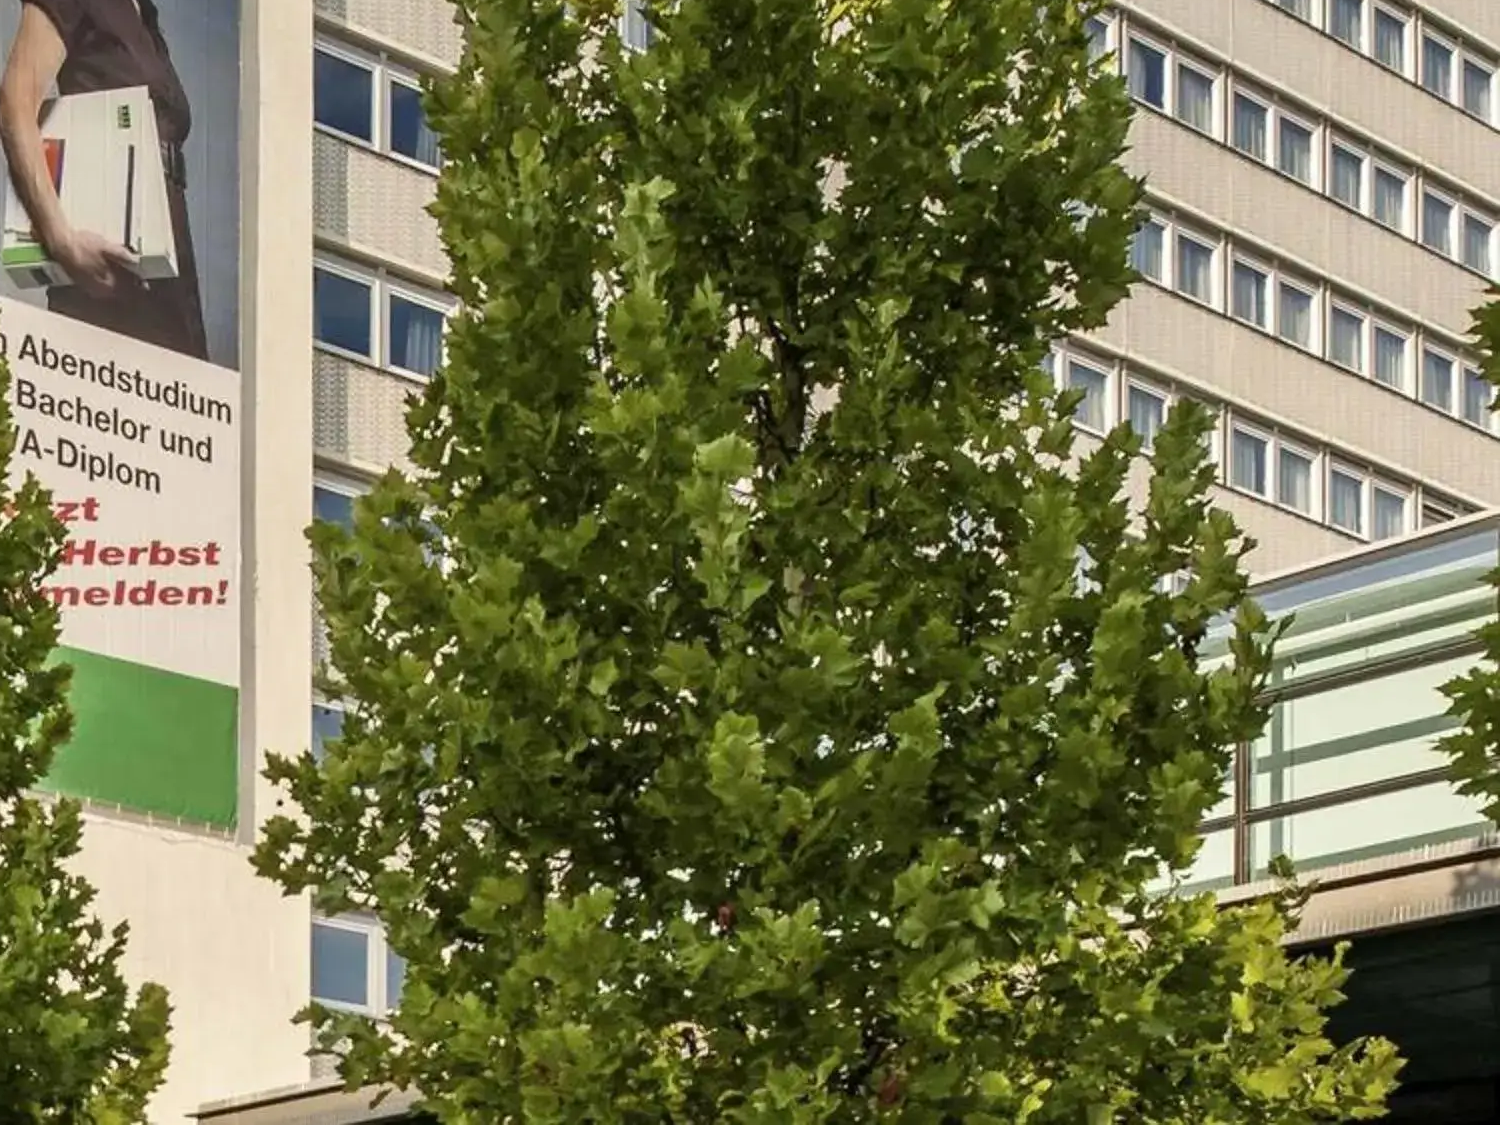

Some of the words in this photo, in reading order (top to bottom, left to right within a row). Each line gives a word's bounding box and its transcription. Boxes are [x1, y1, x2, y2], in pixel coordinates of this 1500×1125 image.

[18, 334, 232, 424] Abendstudium
[16, 378, 151, 444] Bachelor
[160, 429, 213, 463] und
[13, 425, 161, 493] A-Diplom
[55, 496, 100, 522] zt
[61, 540, 221, 566] Herbst
[40, 579, 229, 607] melden!
